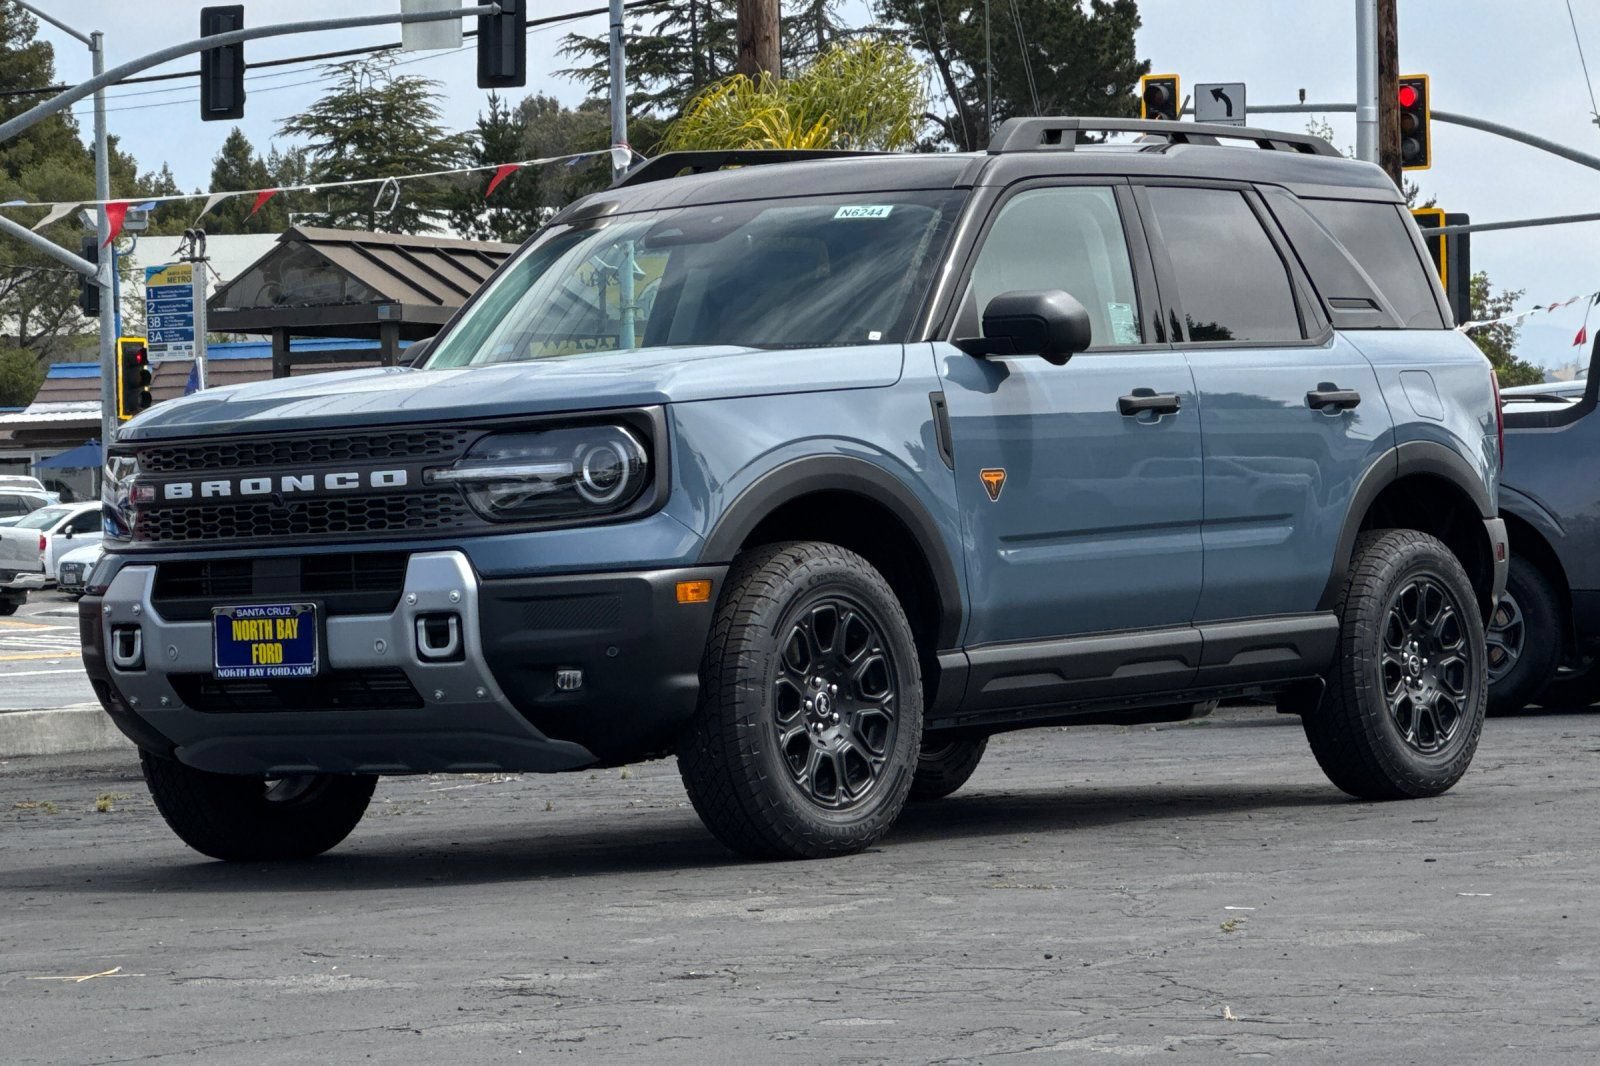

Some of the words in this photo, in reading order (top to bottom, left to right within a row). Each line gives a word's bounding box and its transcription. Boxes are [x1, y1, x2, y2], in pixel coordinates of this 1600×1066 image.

[839, 208, 884, 217] N6244
[167, 276, 192, 284] METRO
[149, 288, 154, 298] 1
[148, 302, 155, 313] 2
[148, 316, 161, 328] 3B
[148, 331, 163, 342] 3A
[164, 469, 407, 499] BRONCO
[236, 608, 266, 617] SANTA
[266, 606, 291, 616] CRUZ
[232, 619, 273, 641] NORTH
[276, 618, 299, 640] BAY
[251, 642, 283, 664] FORD
[217, 668, 247, 677] NORTH
[248, 668, 264, 676] BAY
